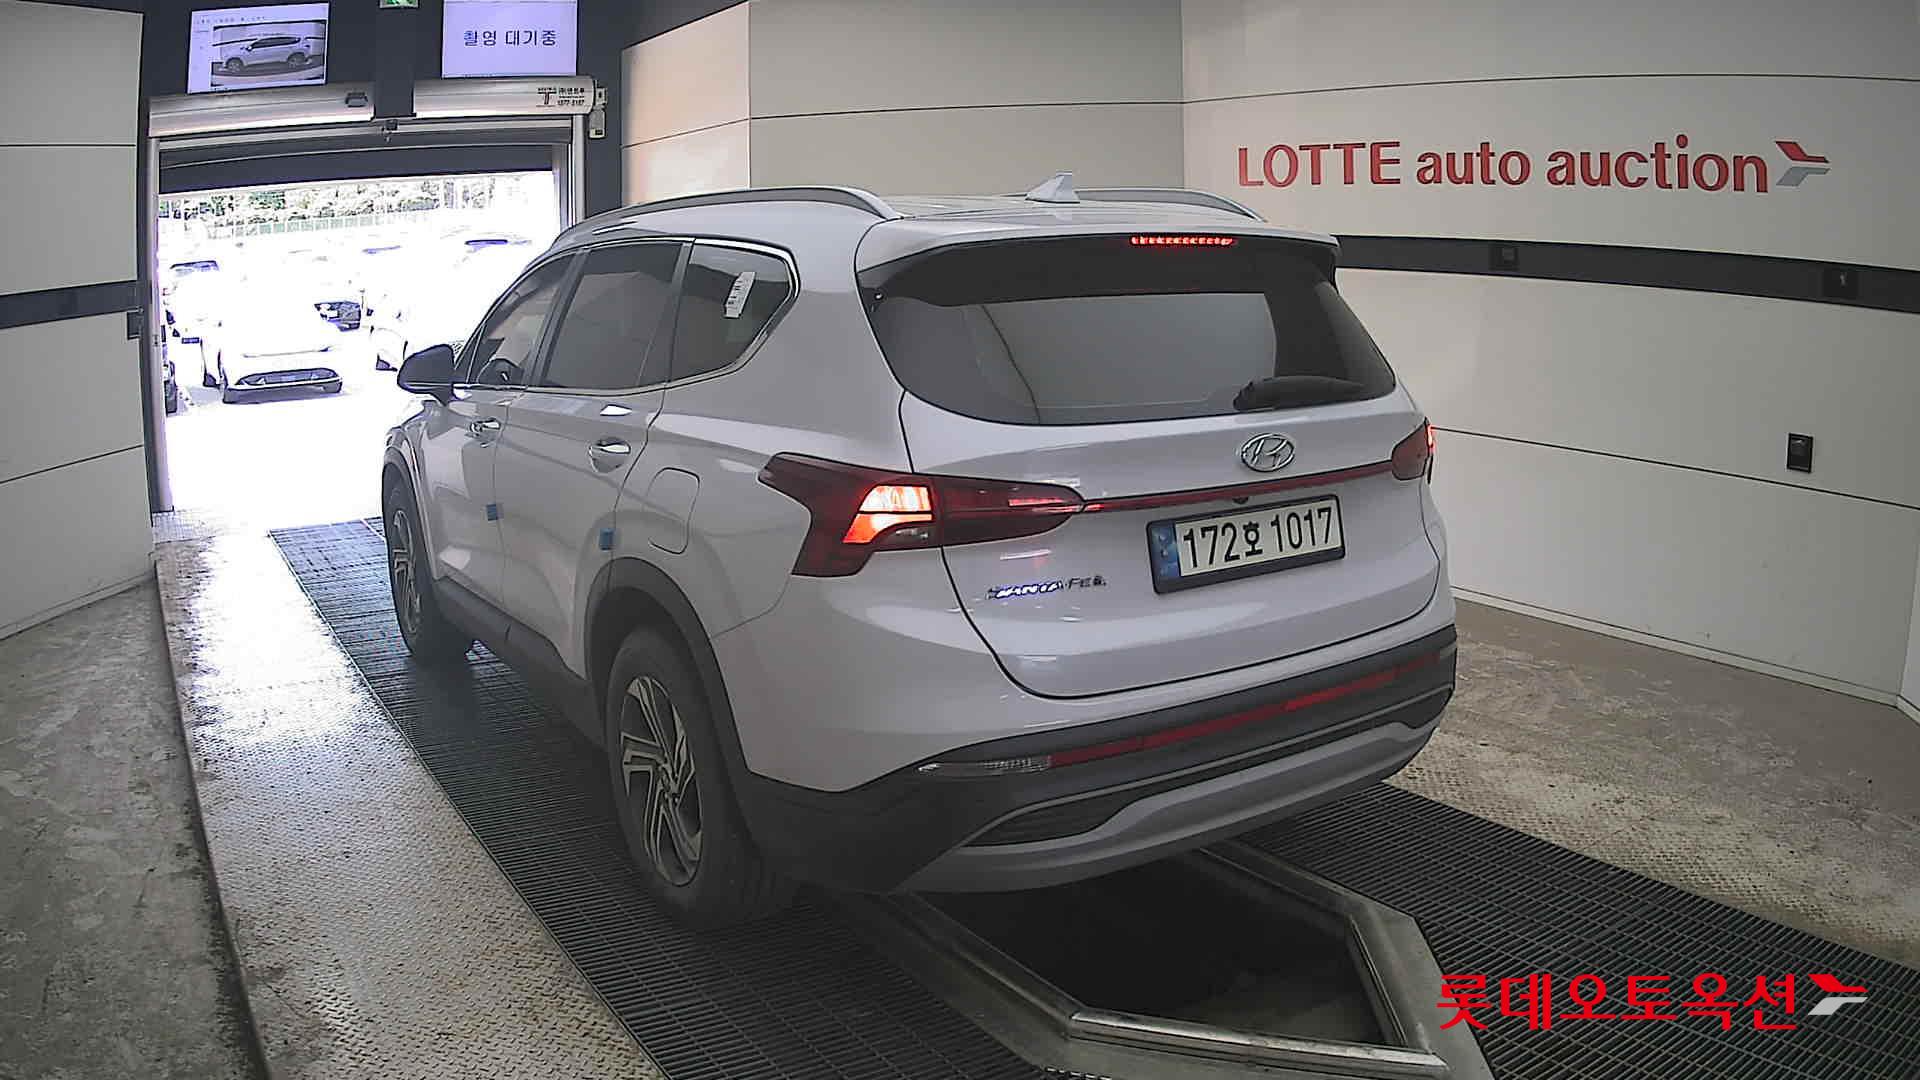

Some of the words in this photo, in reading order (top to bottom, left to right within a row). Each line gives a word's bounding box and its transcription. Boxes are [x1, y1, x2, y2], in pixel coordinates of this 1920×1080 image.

[504, 29, 557, 47] 대기중
[1238, 141, 1401, 187] LOTTE
[1416, 142, 1531, 185] auto
[1546, 134, 1769, 193] auction
[1183, 520, 1263, 568] 172호
[1270, 506, 1332, 552] 1017
